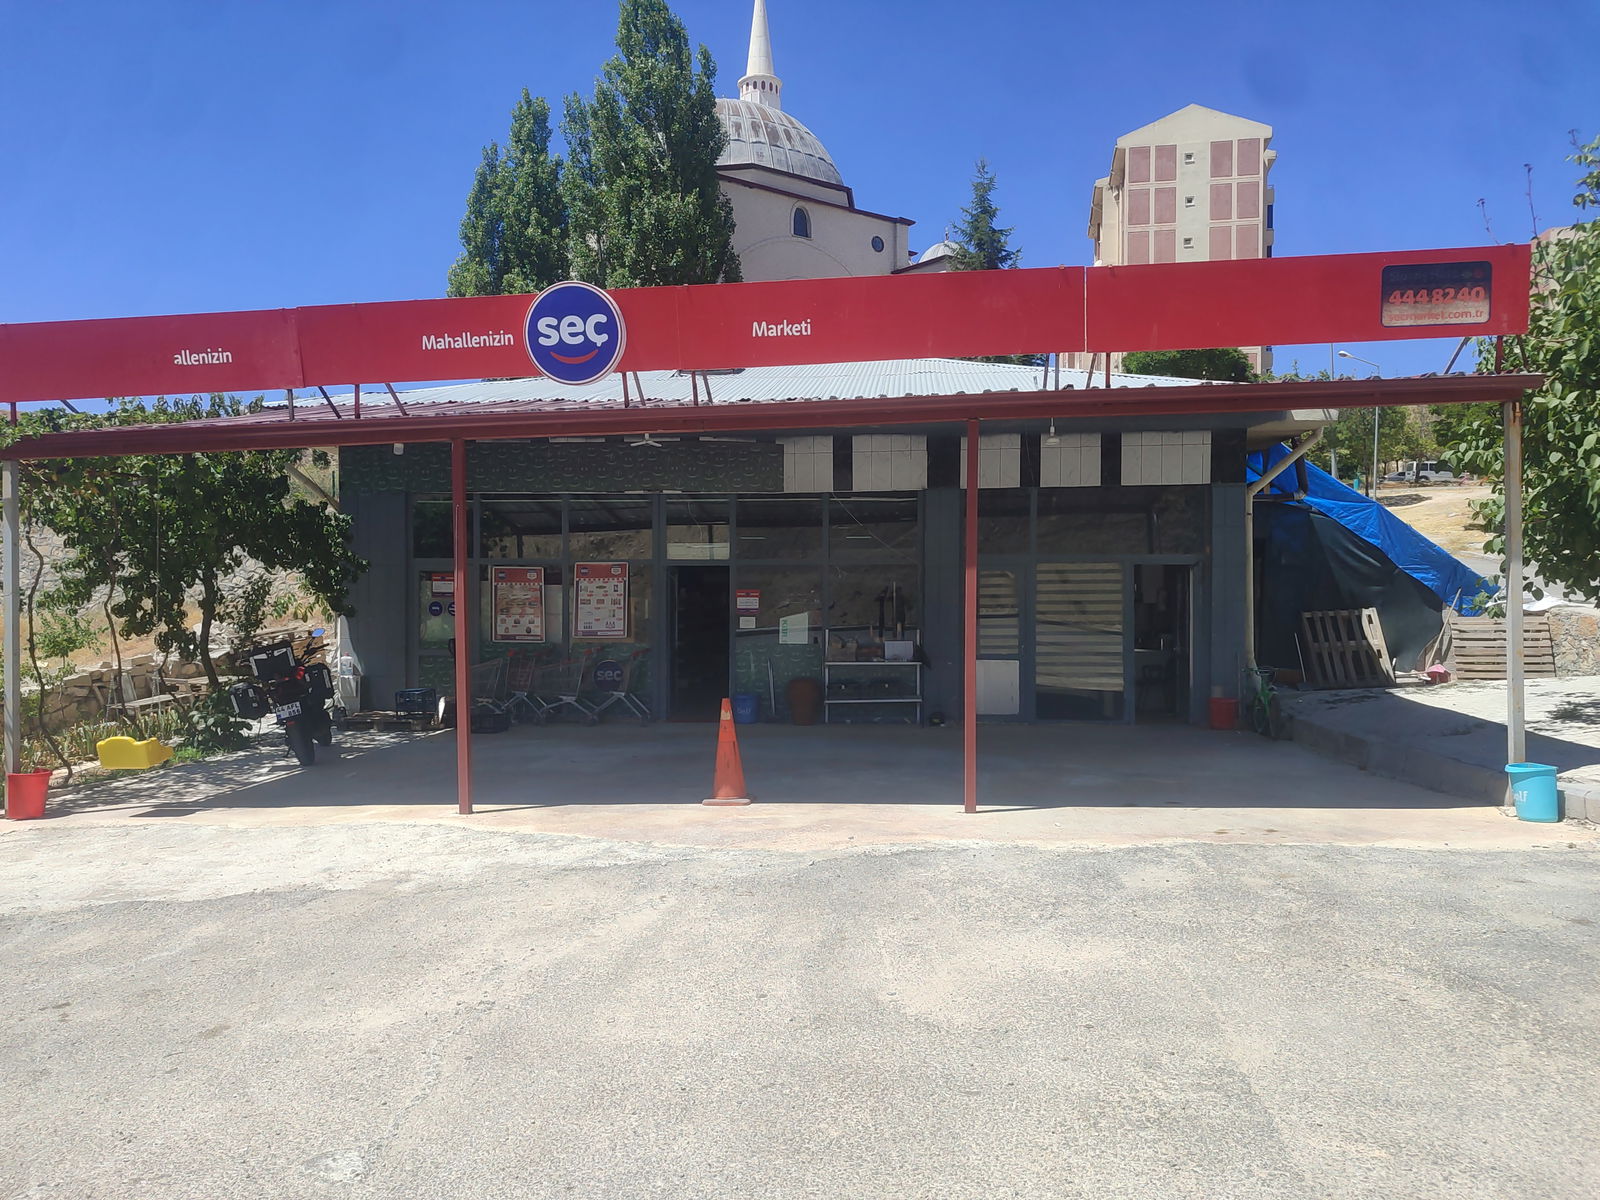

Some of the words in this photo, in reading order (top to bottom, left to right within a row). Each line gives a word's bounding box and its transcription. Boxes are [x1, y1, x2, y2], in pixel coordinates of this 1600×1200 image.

[421, 329, 515, 351] Mahallenizin
[536, 313, 610, 347] seç
[751, 318, 812, 338] Marketi
[173, 347, 233, 367] allenizin
